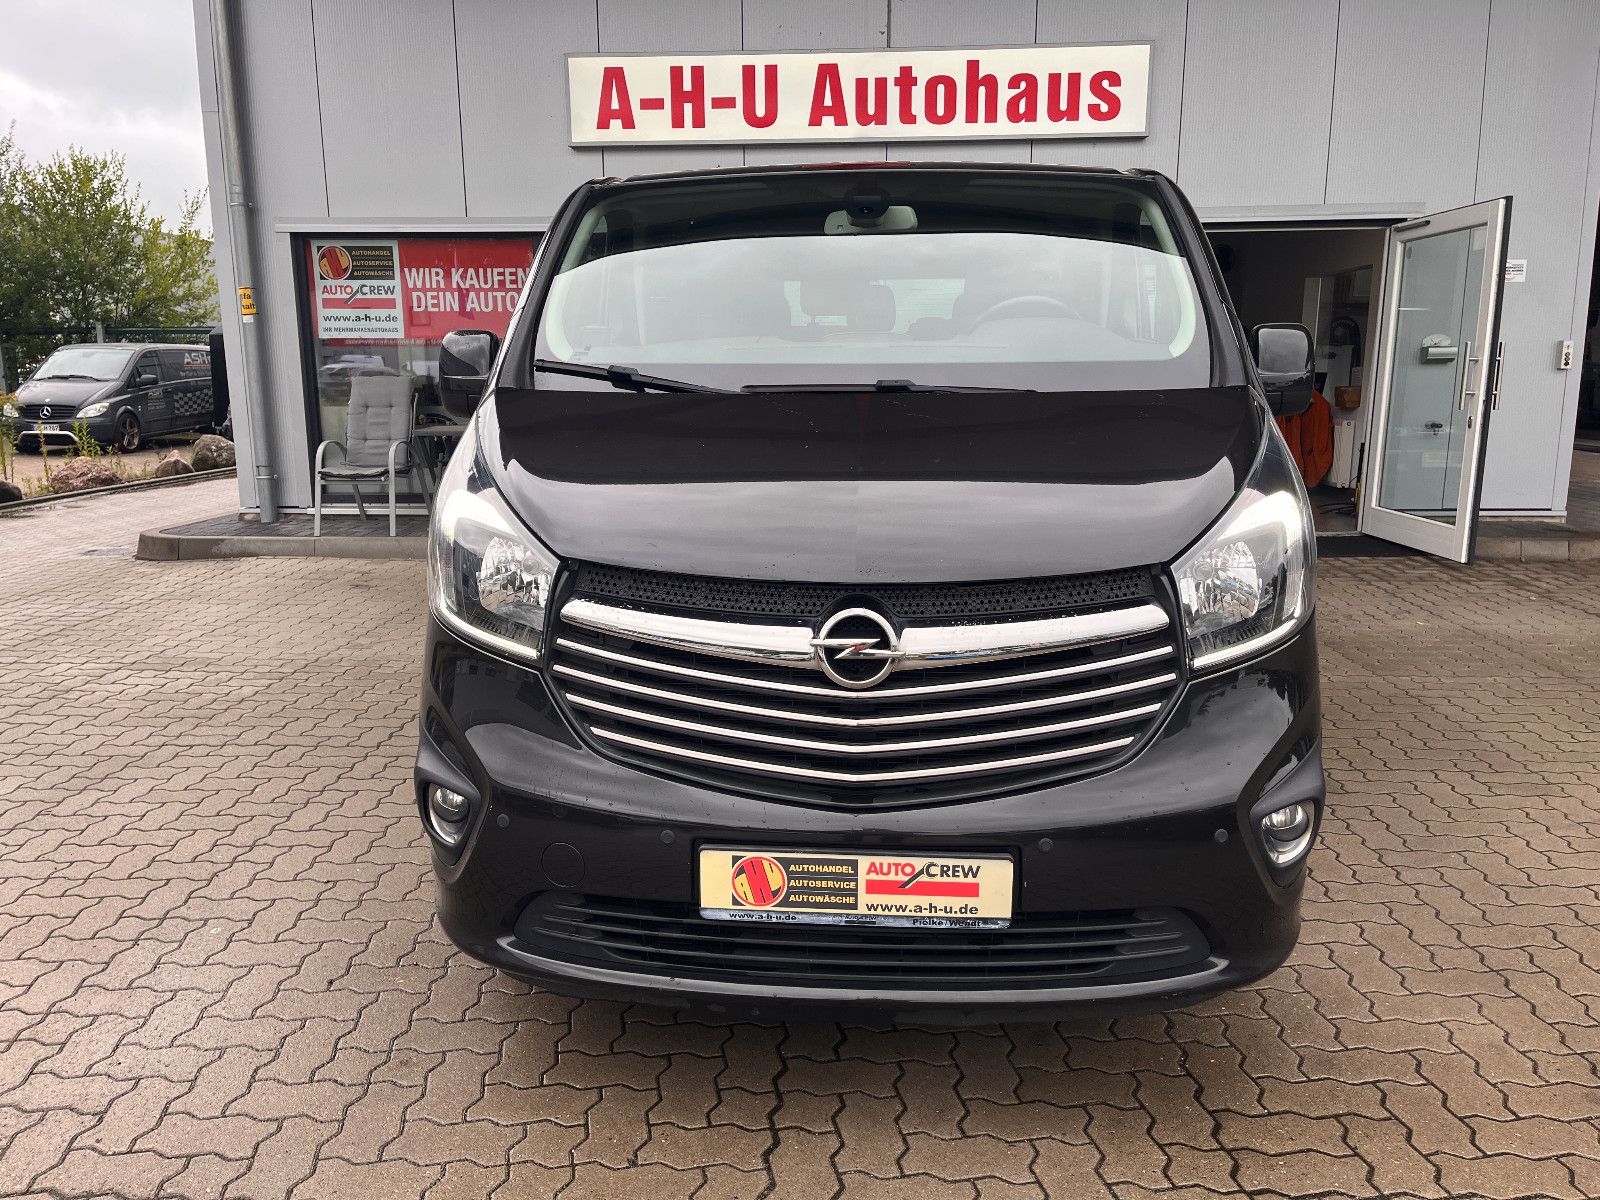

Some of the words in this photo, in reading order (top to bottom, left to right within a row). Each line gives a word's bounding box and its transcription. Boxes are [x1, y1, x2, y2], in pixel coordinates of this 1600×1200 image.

[596, 64, 779, 129] A-H-U
[807, 59, 1122, 127] Autohaus
[404, 267, 445, 288] WIR
[451, 267, 529, 289] KAUFEN
[412, 291, 459, 312] DEIN
[466, 291, 519, 313] AUTO
[322, 313, 398, 322] www.a-h-u.de
[789, 864, 855, 874] AUTOHANDEL
[789, 879, 857, 889] AUTOSERVICE
[789, 894, 856, 904] AUTOWÄSCHE
[865, 902, 979, 915] www.a-h-u.de
[729, 912, 797, 921] www.a-h-u.de
